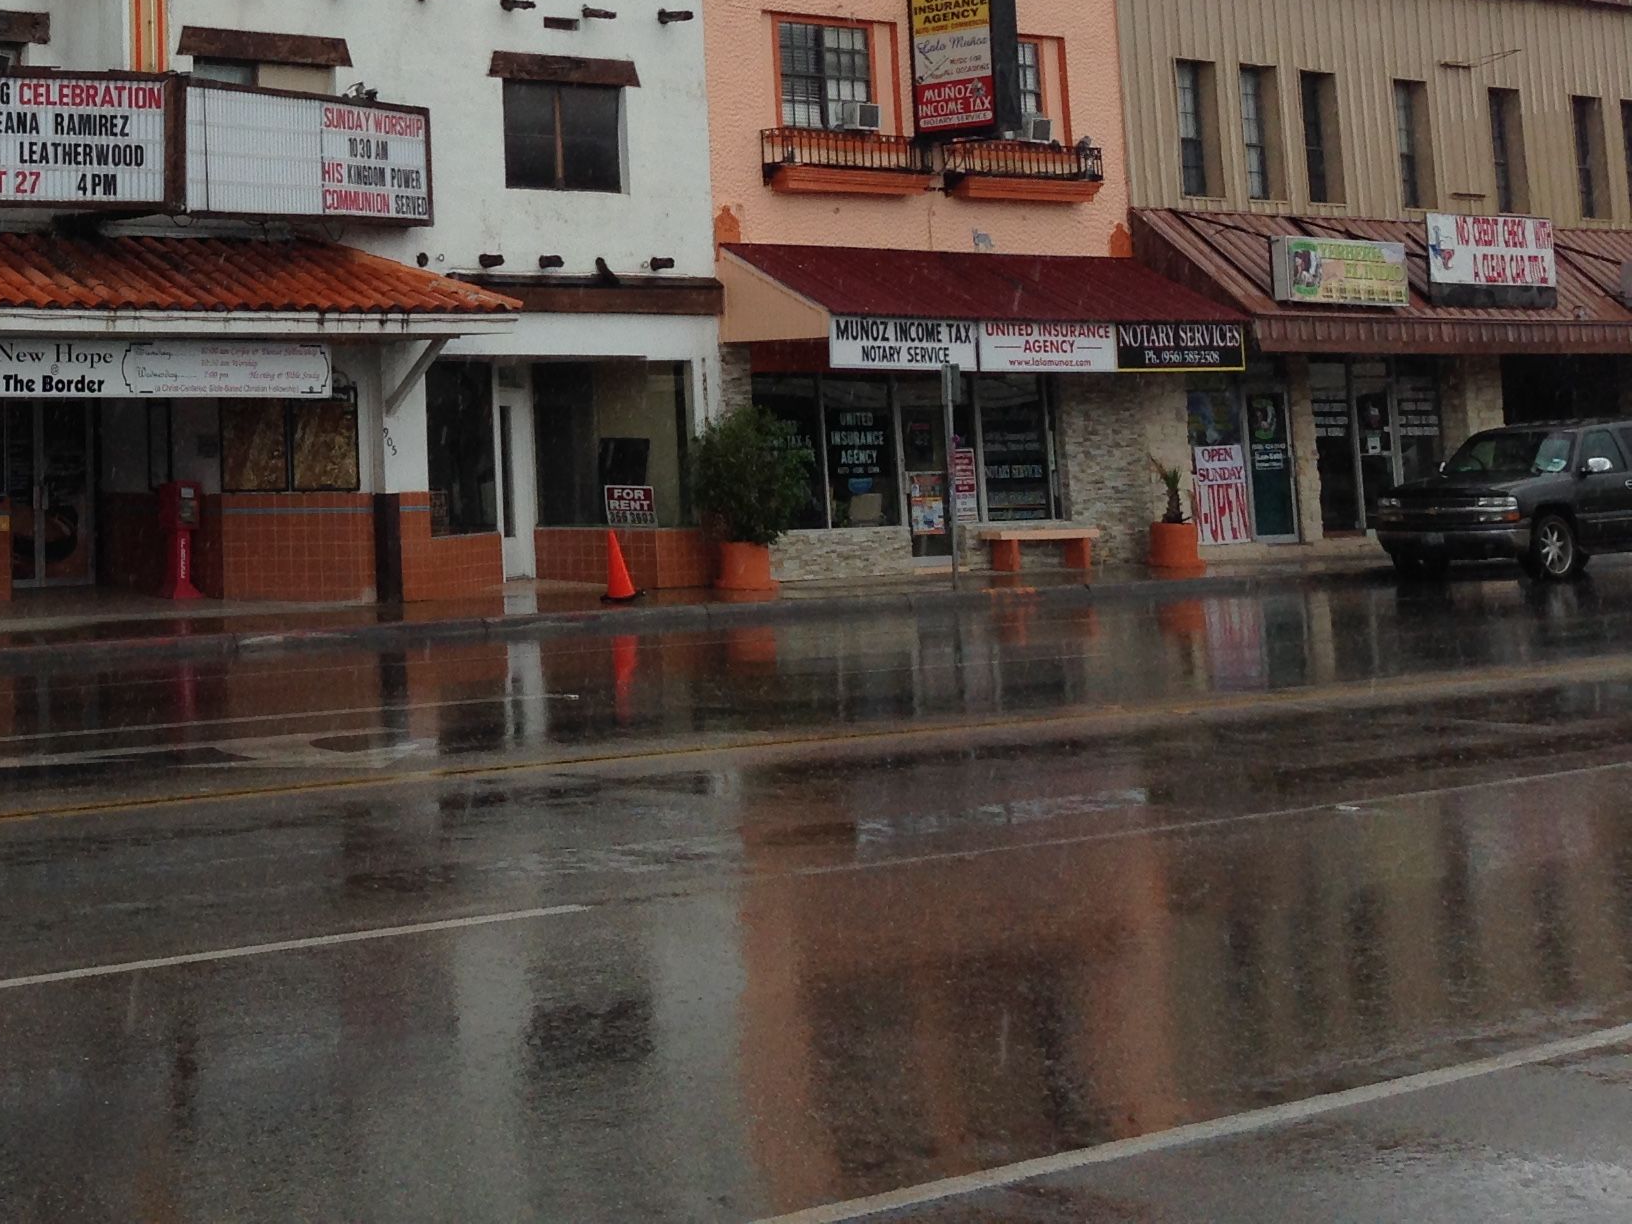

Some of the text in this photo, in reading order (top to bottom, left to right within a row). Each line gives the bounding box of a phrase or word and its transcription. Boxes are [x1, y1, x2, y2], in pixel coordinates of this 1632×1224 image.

[923, 8, 979, 25] AGENCY
[19, 83, 162, 109] CELEBRATION
[923, 84, 972, 102] MUÑOZ
[919, 96, 991, 116] INCOME TAX
[54, 113, 129, 137] RAMIREZ
[324, 107, 423, 137] SUNDAY WORSHIP
[924, 112, 989, 126] NOTARY SERVICE
[19, 142, 144, 167] LEATHERWOOD
[375, 140, 388, 160] AM
[15, 171, 41, 194] 27
[322, 161, 421, 189] HIS KINGDOM POWER
[395, 194, 428, 215] SERVED
[1455, 216, 1469, 246] NO
[1473, 217, 1499, 247] CREDIT
[1503, 219, 1527, 248] CHECK
[1473, 254, 1548, 284] A CLEAR CAR TITLE
[895, 321, 942, 342] INCOME
[945, 323, 971, 344] TAX
[985, 322, 1110, 338] UNITED INSURANCE
[1119, 324, 1240, 347] NOTARY SERVICES
[862, 345, 949, 364] NOTARY SERVICE
[1023, 339, 1075, 353] AGENCY
[54, 343, 113, 369] Hope
[1144, 350, 1159, 364] Ph.
[1161, 350, 1182, 363] (956)
[3, 374, 104, 393] The Border
[840, 412, 874, 426] UNITED
[383, 427, 397, 456] 905
[831, 431, 884, 445] INSURANCE
[841, 450, 877, 464] AGENCY
[1202, 448, 1233, 463] OPEN
[1198, 466, 1243, 483] SUNDAY
[614, 489, 644, 499] FOR
[610, 500, 650, 510] RENT
